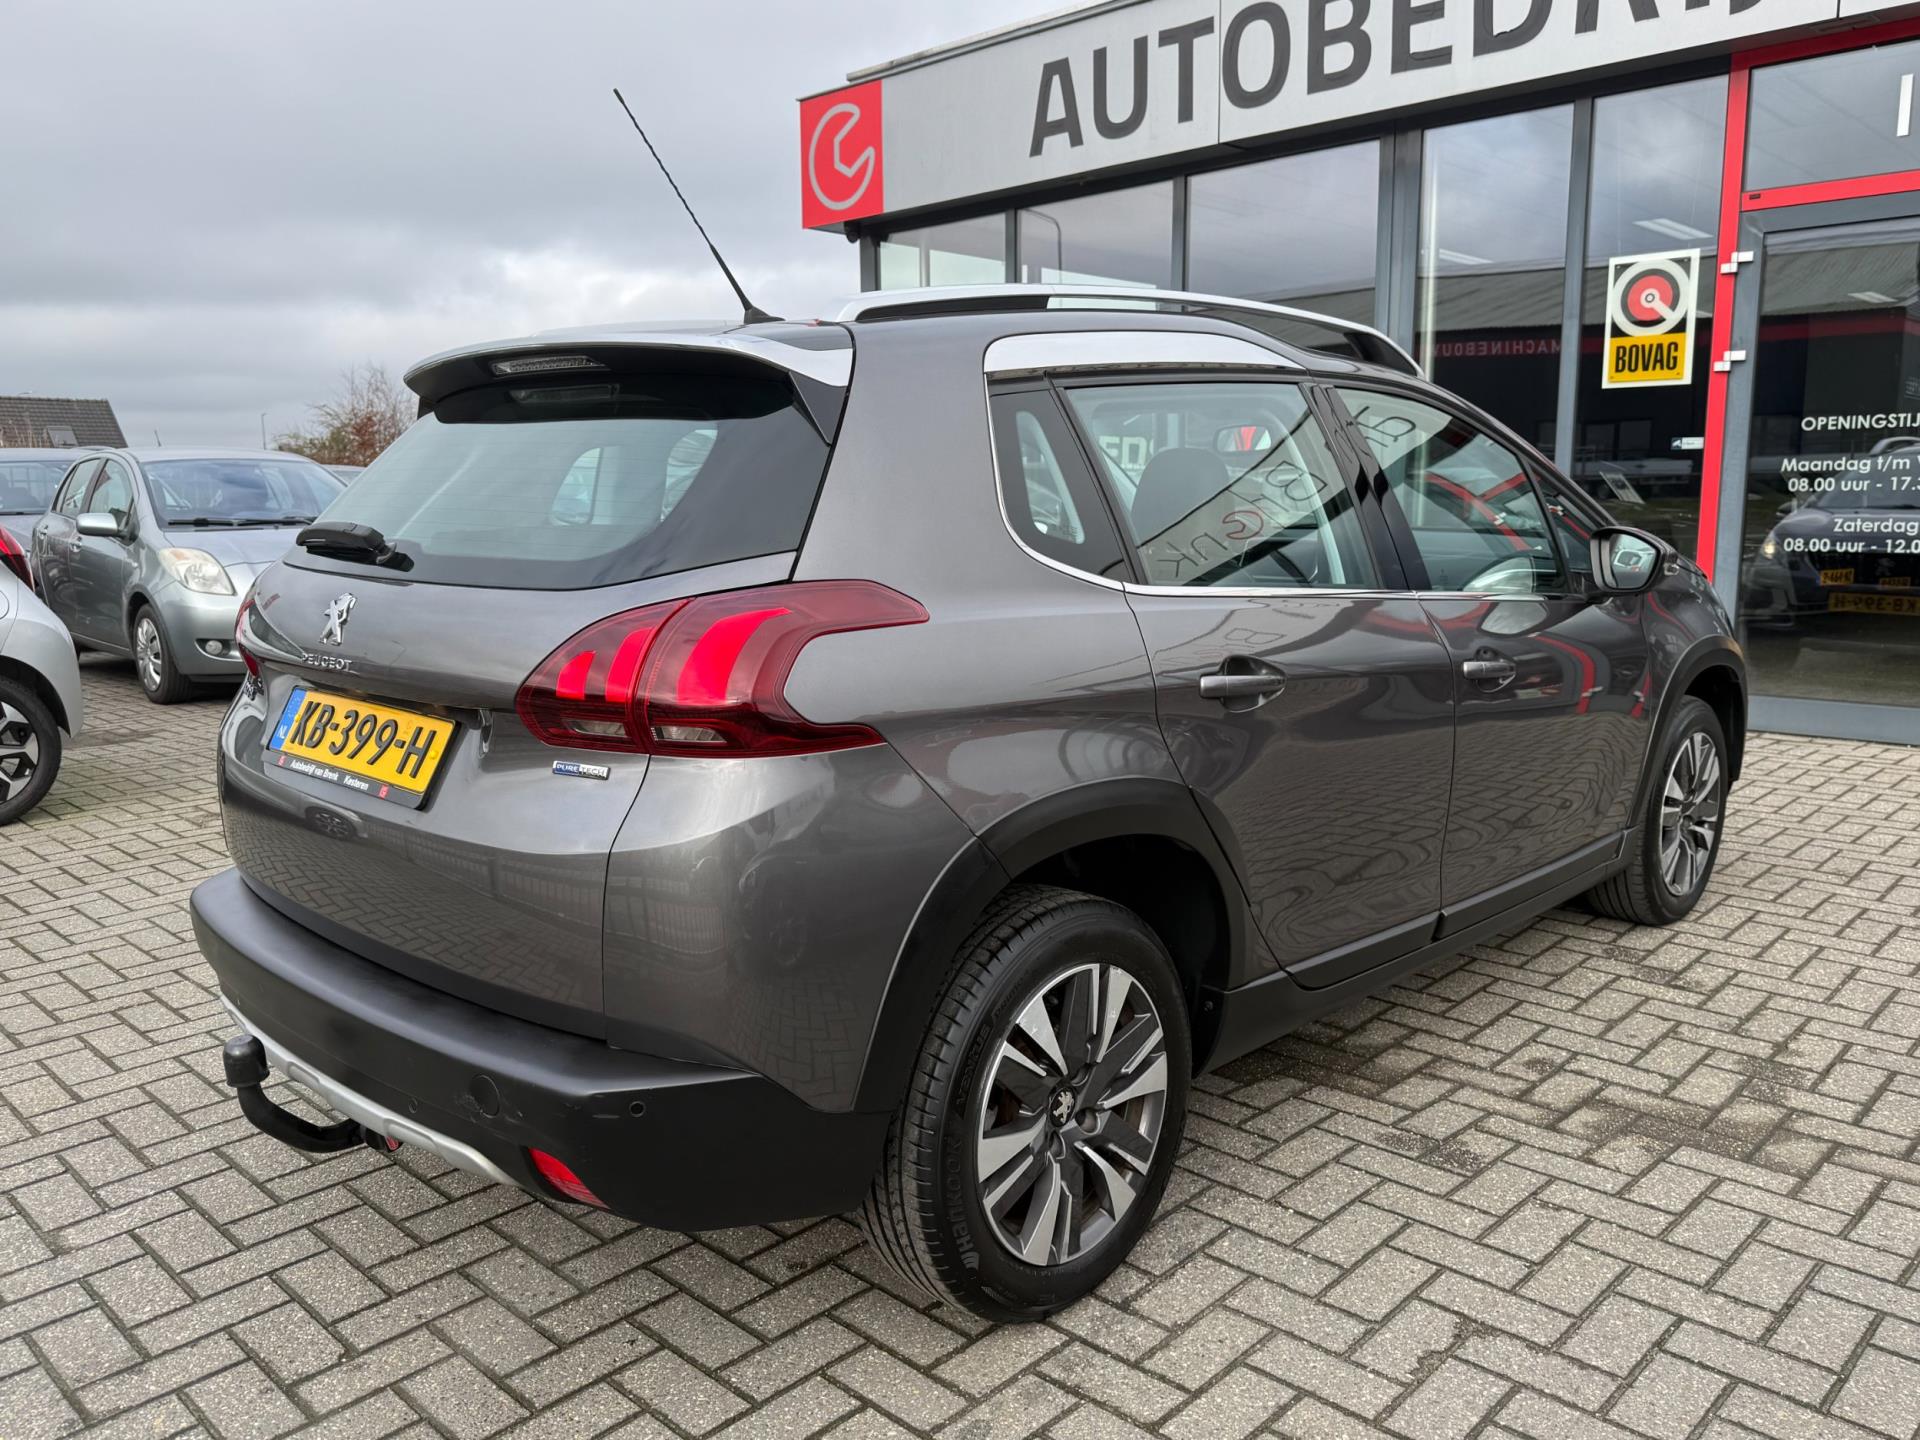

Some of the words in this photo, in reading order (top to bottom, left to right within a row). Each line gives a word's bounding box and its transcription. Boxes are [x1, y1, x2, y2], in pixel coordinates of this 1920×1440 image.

[1029, 0, 1763, 157] AUTOBE
[1615, 341, 1679, 373] BOVAG
[1801, 412, 1920, 431] OPENINGSTIJ
[1781, 456, 1871, 474] Maandag
[1877, 455, 1910, 472] t/m
[1788, 477, 1835, 492] 08.00
[1841, 480, 1870, 491] uur
[1833, 518, 1919, 536] Zaterdag
[1783, 538, 1830, 552] 08.00
[1836, 542, 1865, 552] uur
[1885, 539, 1920, 554] 12.0
[301, 652, 353, 672] PEUGEOT
[277, 725, 288, 739] NL
[289, 701, 438, 779] KB-399-H
